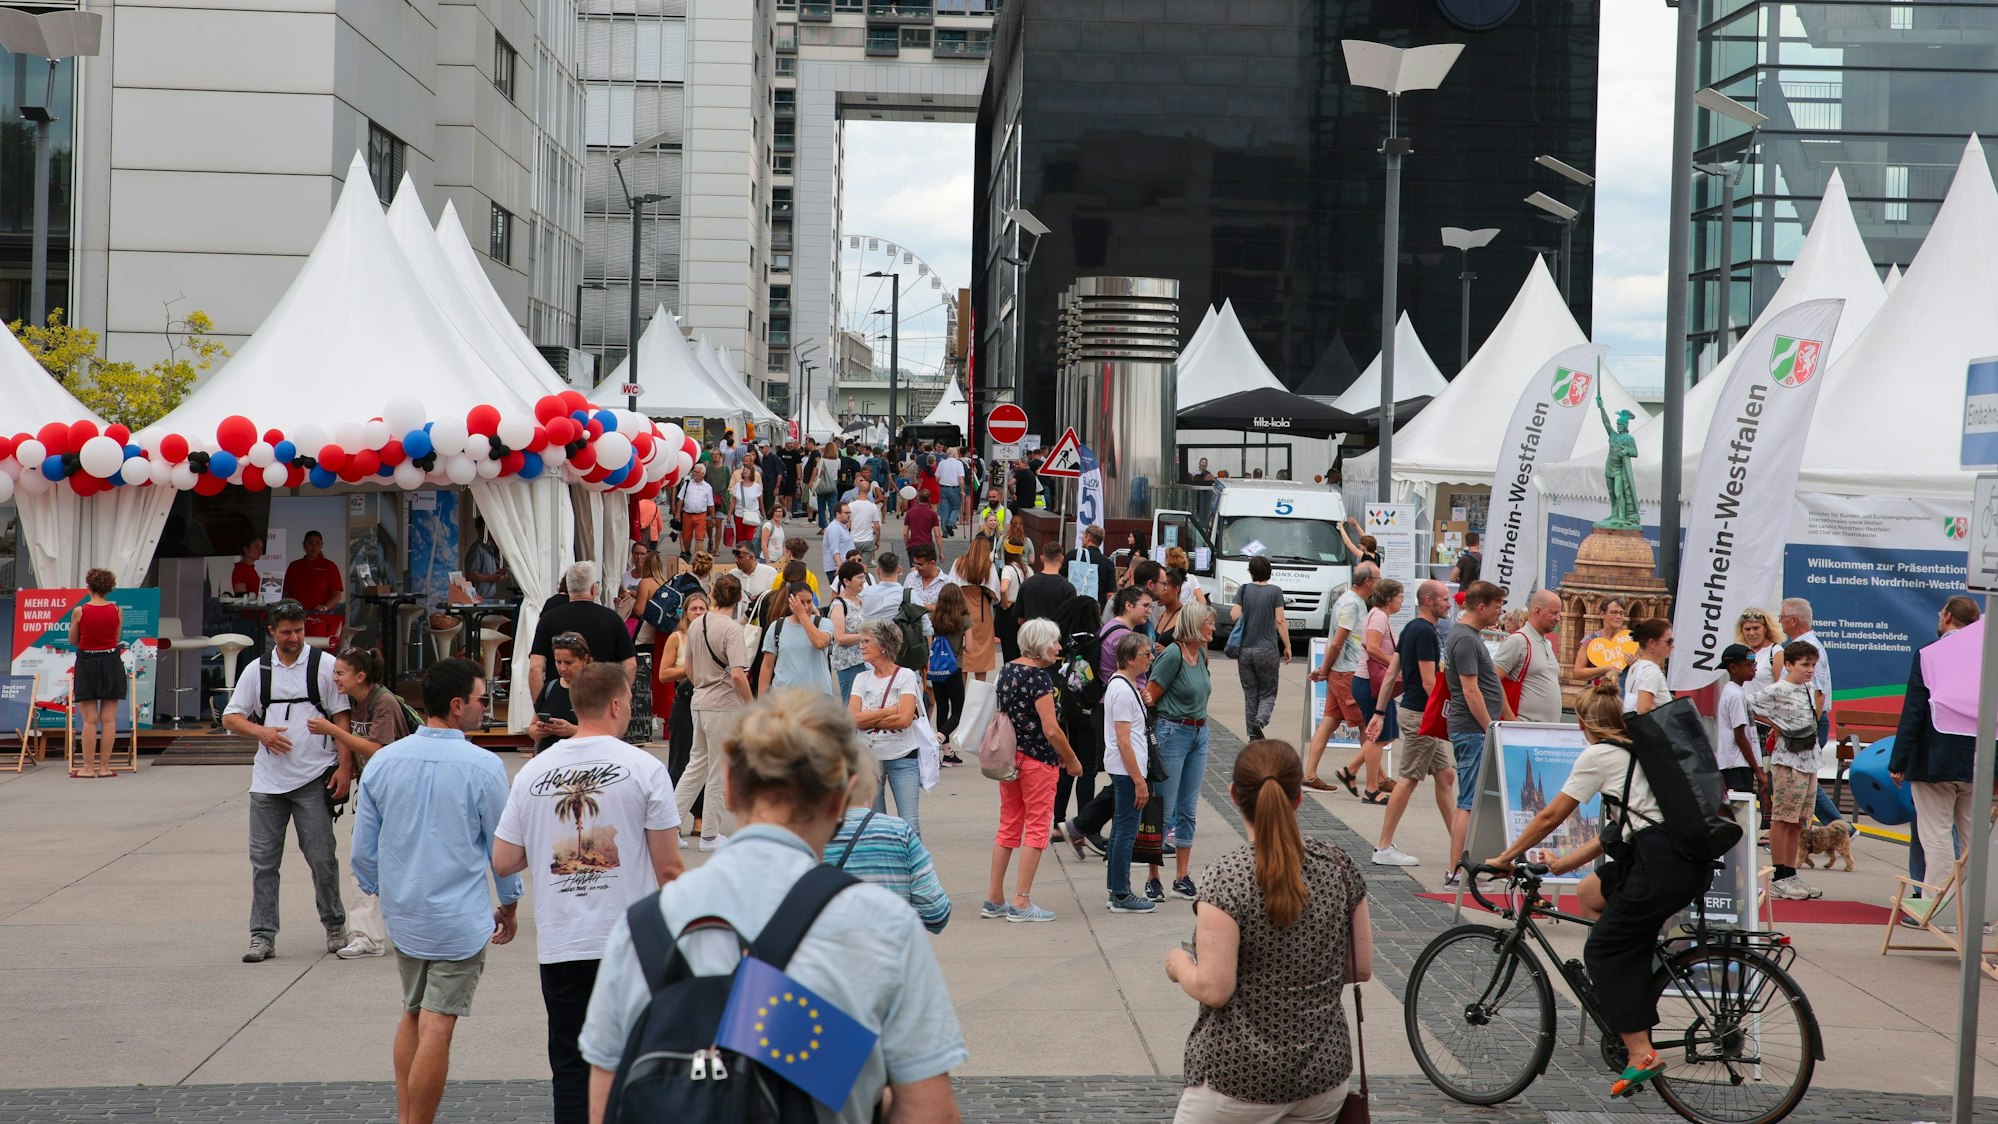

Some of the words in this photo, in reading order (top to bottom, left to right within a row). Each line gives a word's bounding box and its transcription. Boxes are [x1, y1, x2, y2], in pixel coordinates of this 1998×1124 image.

[623, 384, 639, 394] WC
[1253, 416, 1291, 428] fritz-kola
[1080, 487, 1097, 526] 5
[1274, 501, 1294, 515] 5
[1497, 401, 1549, 613] ordrhein-Westfalen
[1692, 384, 1768, 672] Nordrhein-Westfalen
[1807, 558, 1874, 571] Willkommen
[1876, 562, 1895, 572] zur
[1897, 562, 1967, 575] Präsentation
[1807, 574, 1827, 584] des
[1829, 574, 1869, 586] Landes
[24, 598, 50, 608] MEHR
[51, 598, 67, 608] ALS
[24, 610, 51, 620] WARM
[23, 622, 42, 632] UND
[43, 621, 71, 632] TROCK
[1811, 619, 1837, 627] nsere
[1838, 619, 1873, 629] Themen
[1875, 620, 1889, 629] als
[1812, 629, 1839, 638] berste
[1841, 629, 1908, 641] Landesbehörde
[1823, 640, 1911, 652] Ministerpräsidenten
[1602, 646, 1624, 662] DIR
[1704, 897, 1733, 909] ERFT
